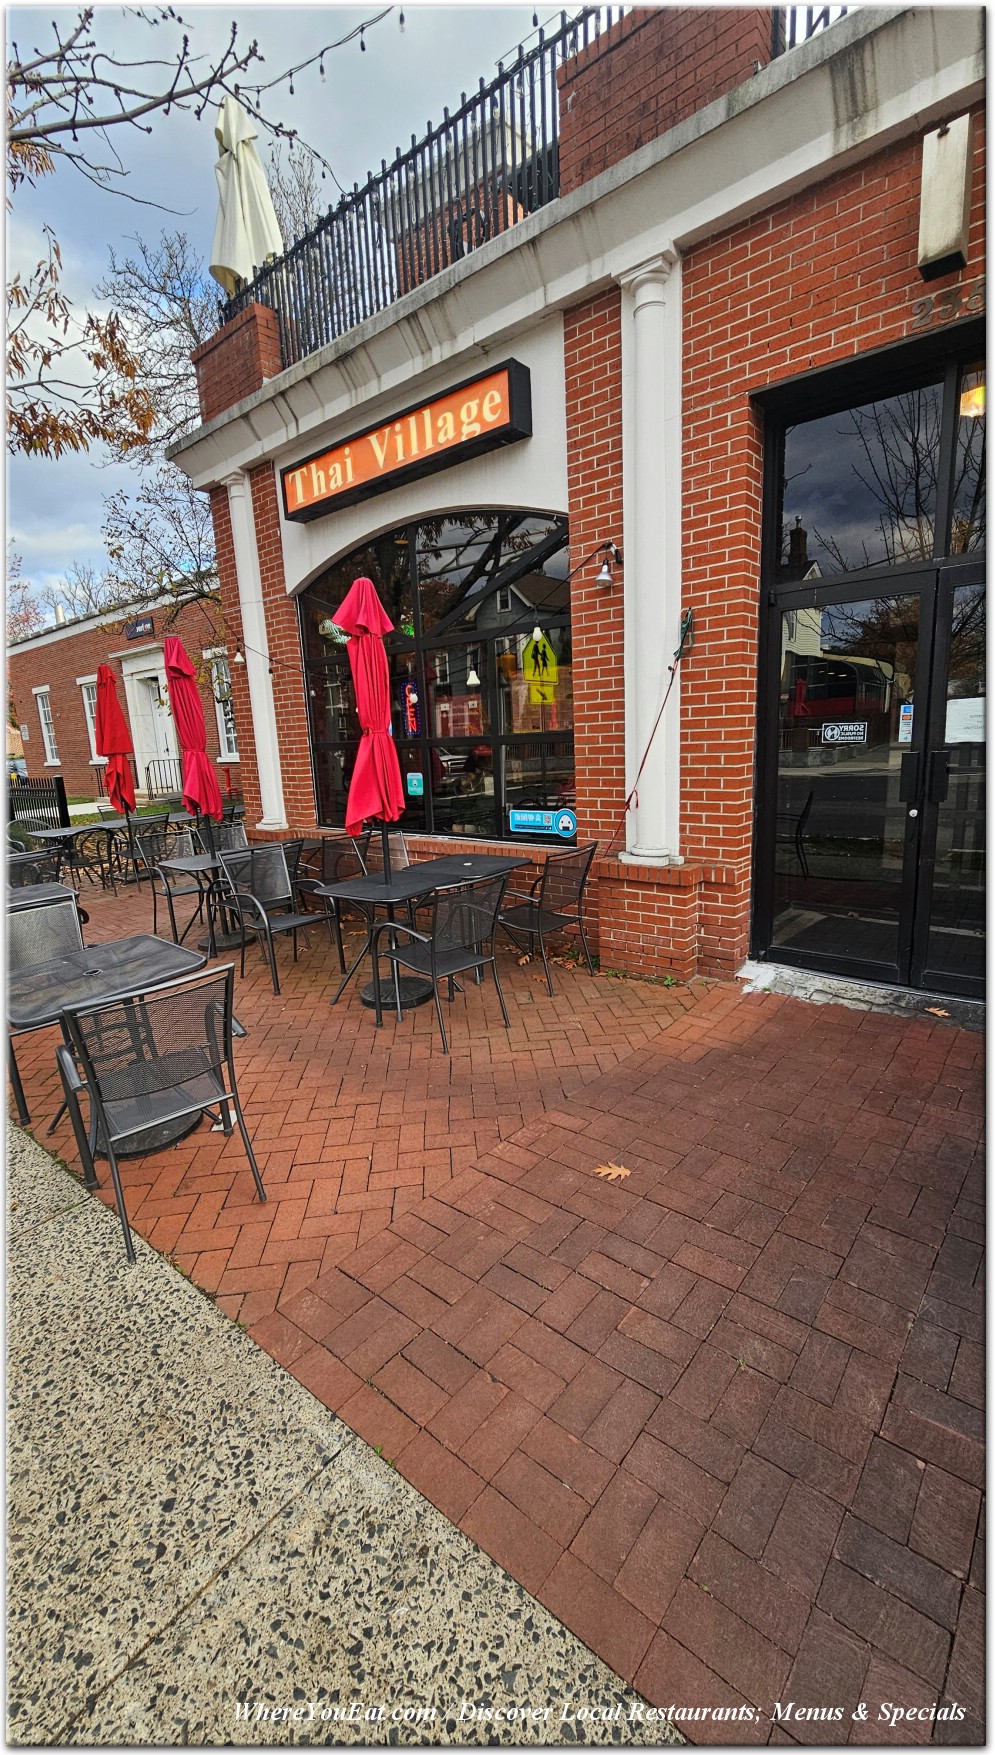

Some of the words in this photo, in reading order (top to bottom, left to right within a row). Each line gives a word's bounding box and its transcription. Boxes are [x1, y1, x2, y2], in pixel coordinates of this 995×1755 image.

[911, 281, 986, 329] 235
[288, 446, 355, 506] Thai
[367, 389, 502, 470] Village
